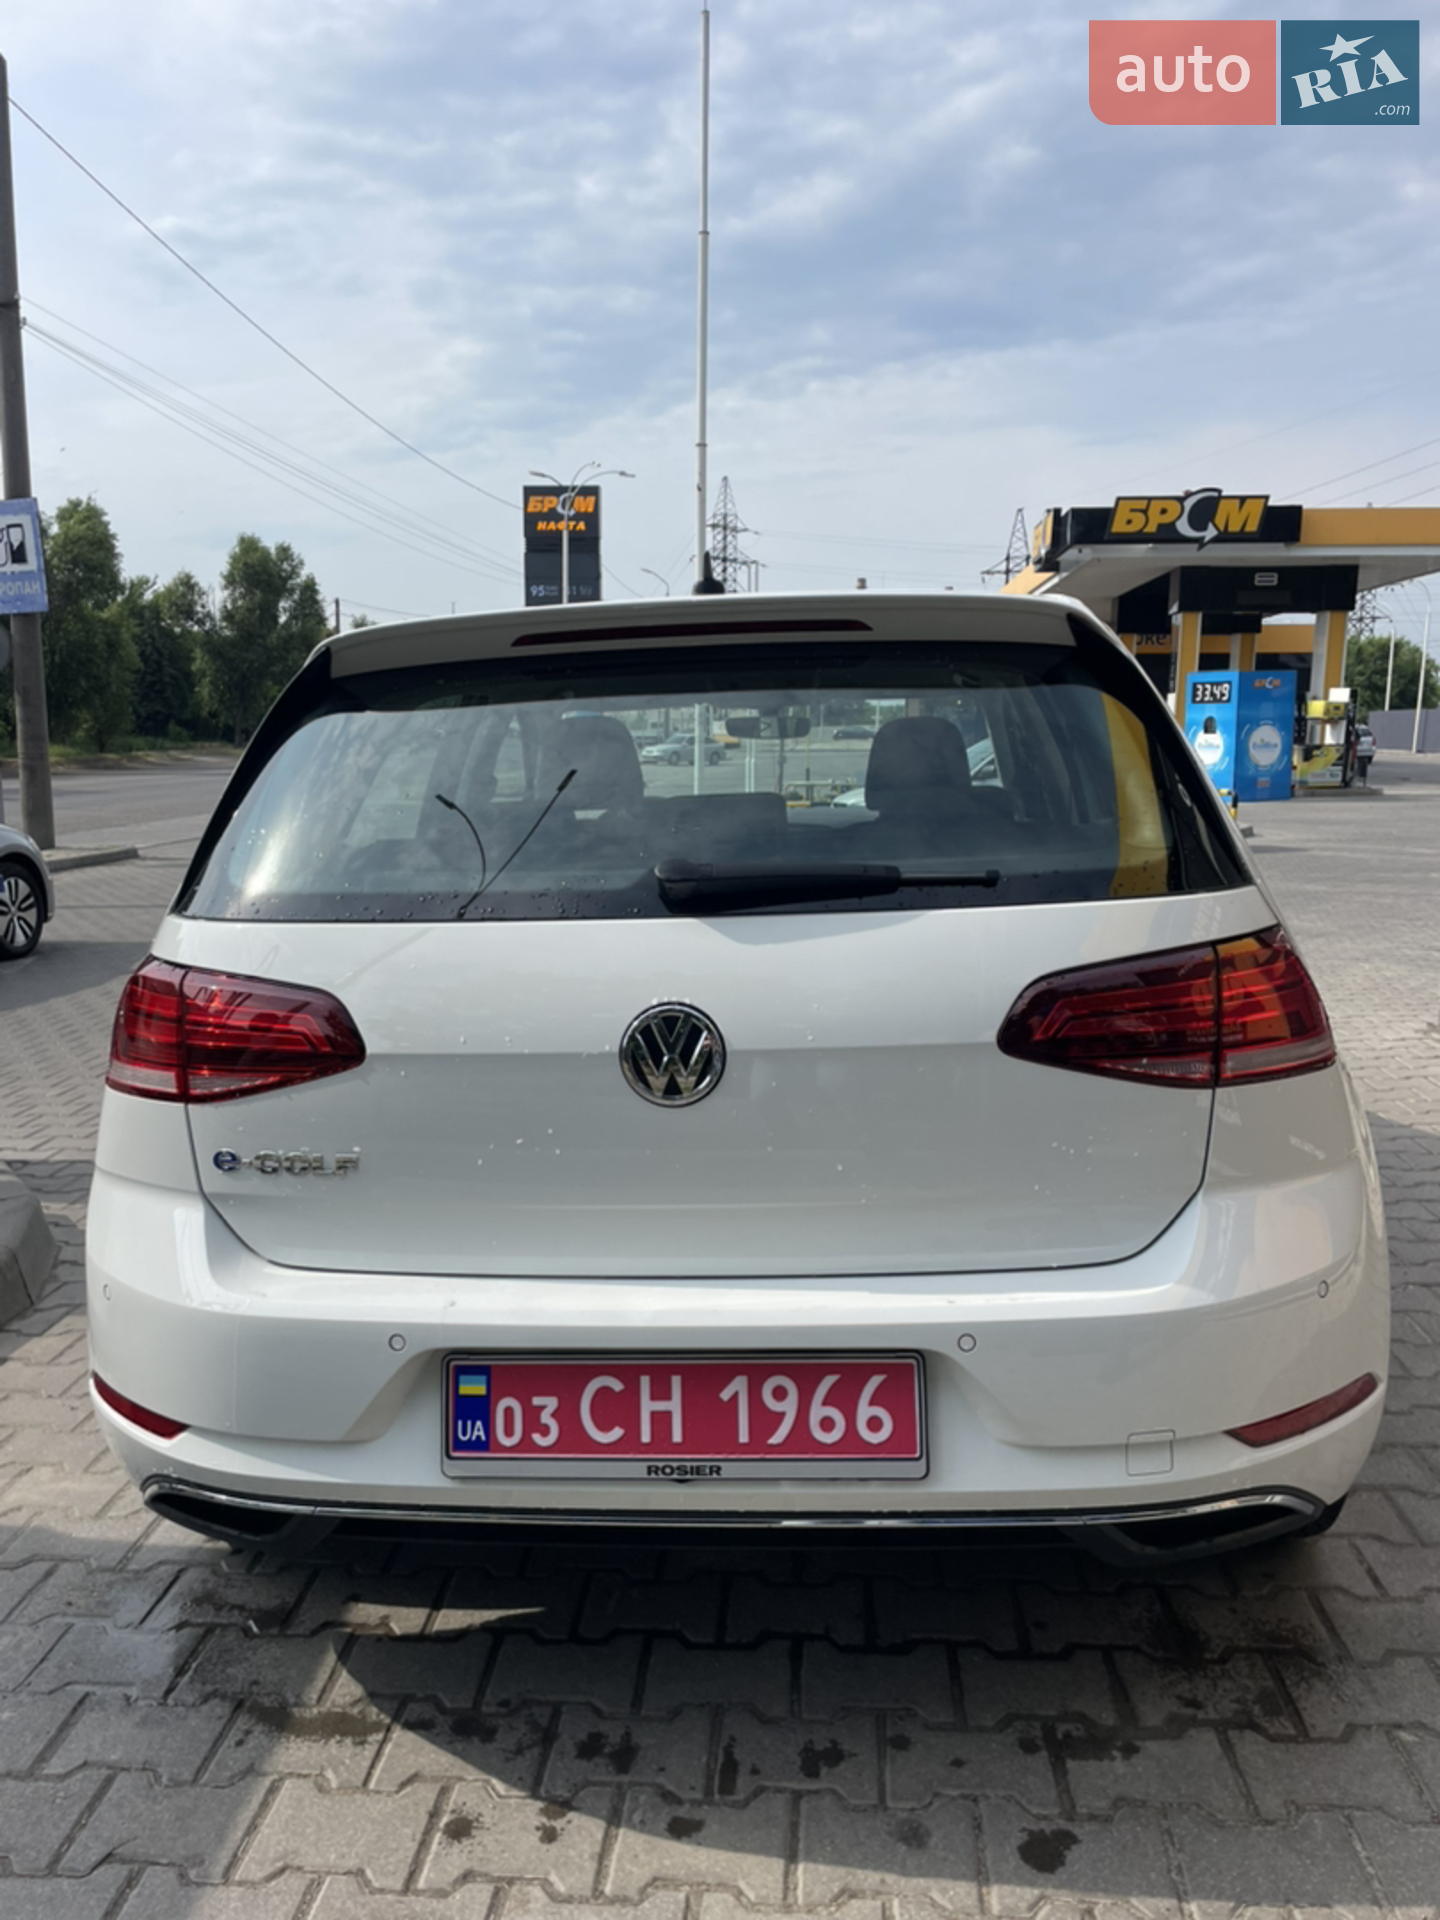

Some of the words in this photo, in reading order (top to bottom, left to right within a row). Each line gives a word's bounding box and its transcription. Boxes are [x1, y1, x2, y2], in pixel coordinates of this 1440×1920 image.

[1109, 487, 1268, 545] БРСМ
[1194, 682, 1231, 702] 33.49
[494, 1396, 560, 1448] 03
[579, 1374, 684, 1445] CH
[718, 1373, 894, 1446] 1966
[457, 1420, 487, 1442] UA
[646, 1464, 722, 1477] ROSIER
